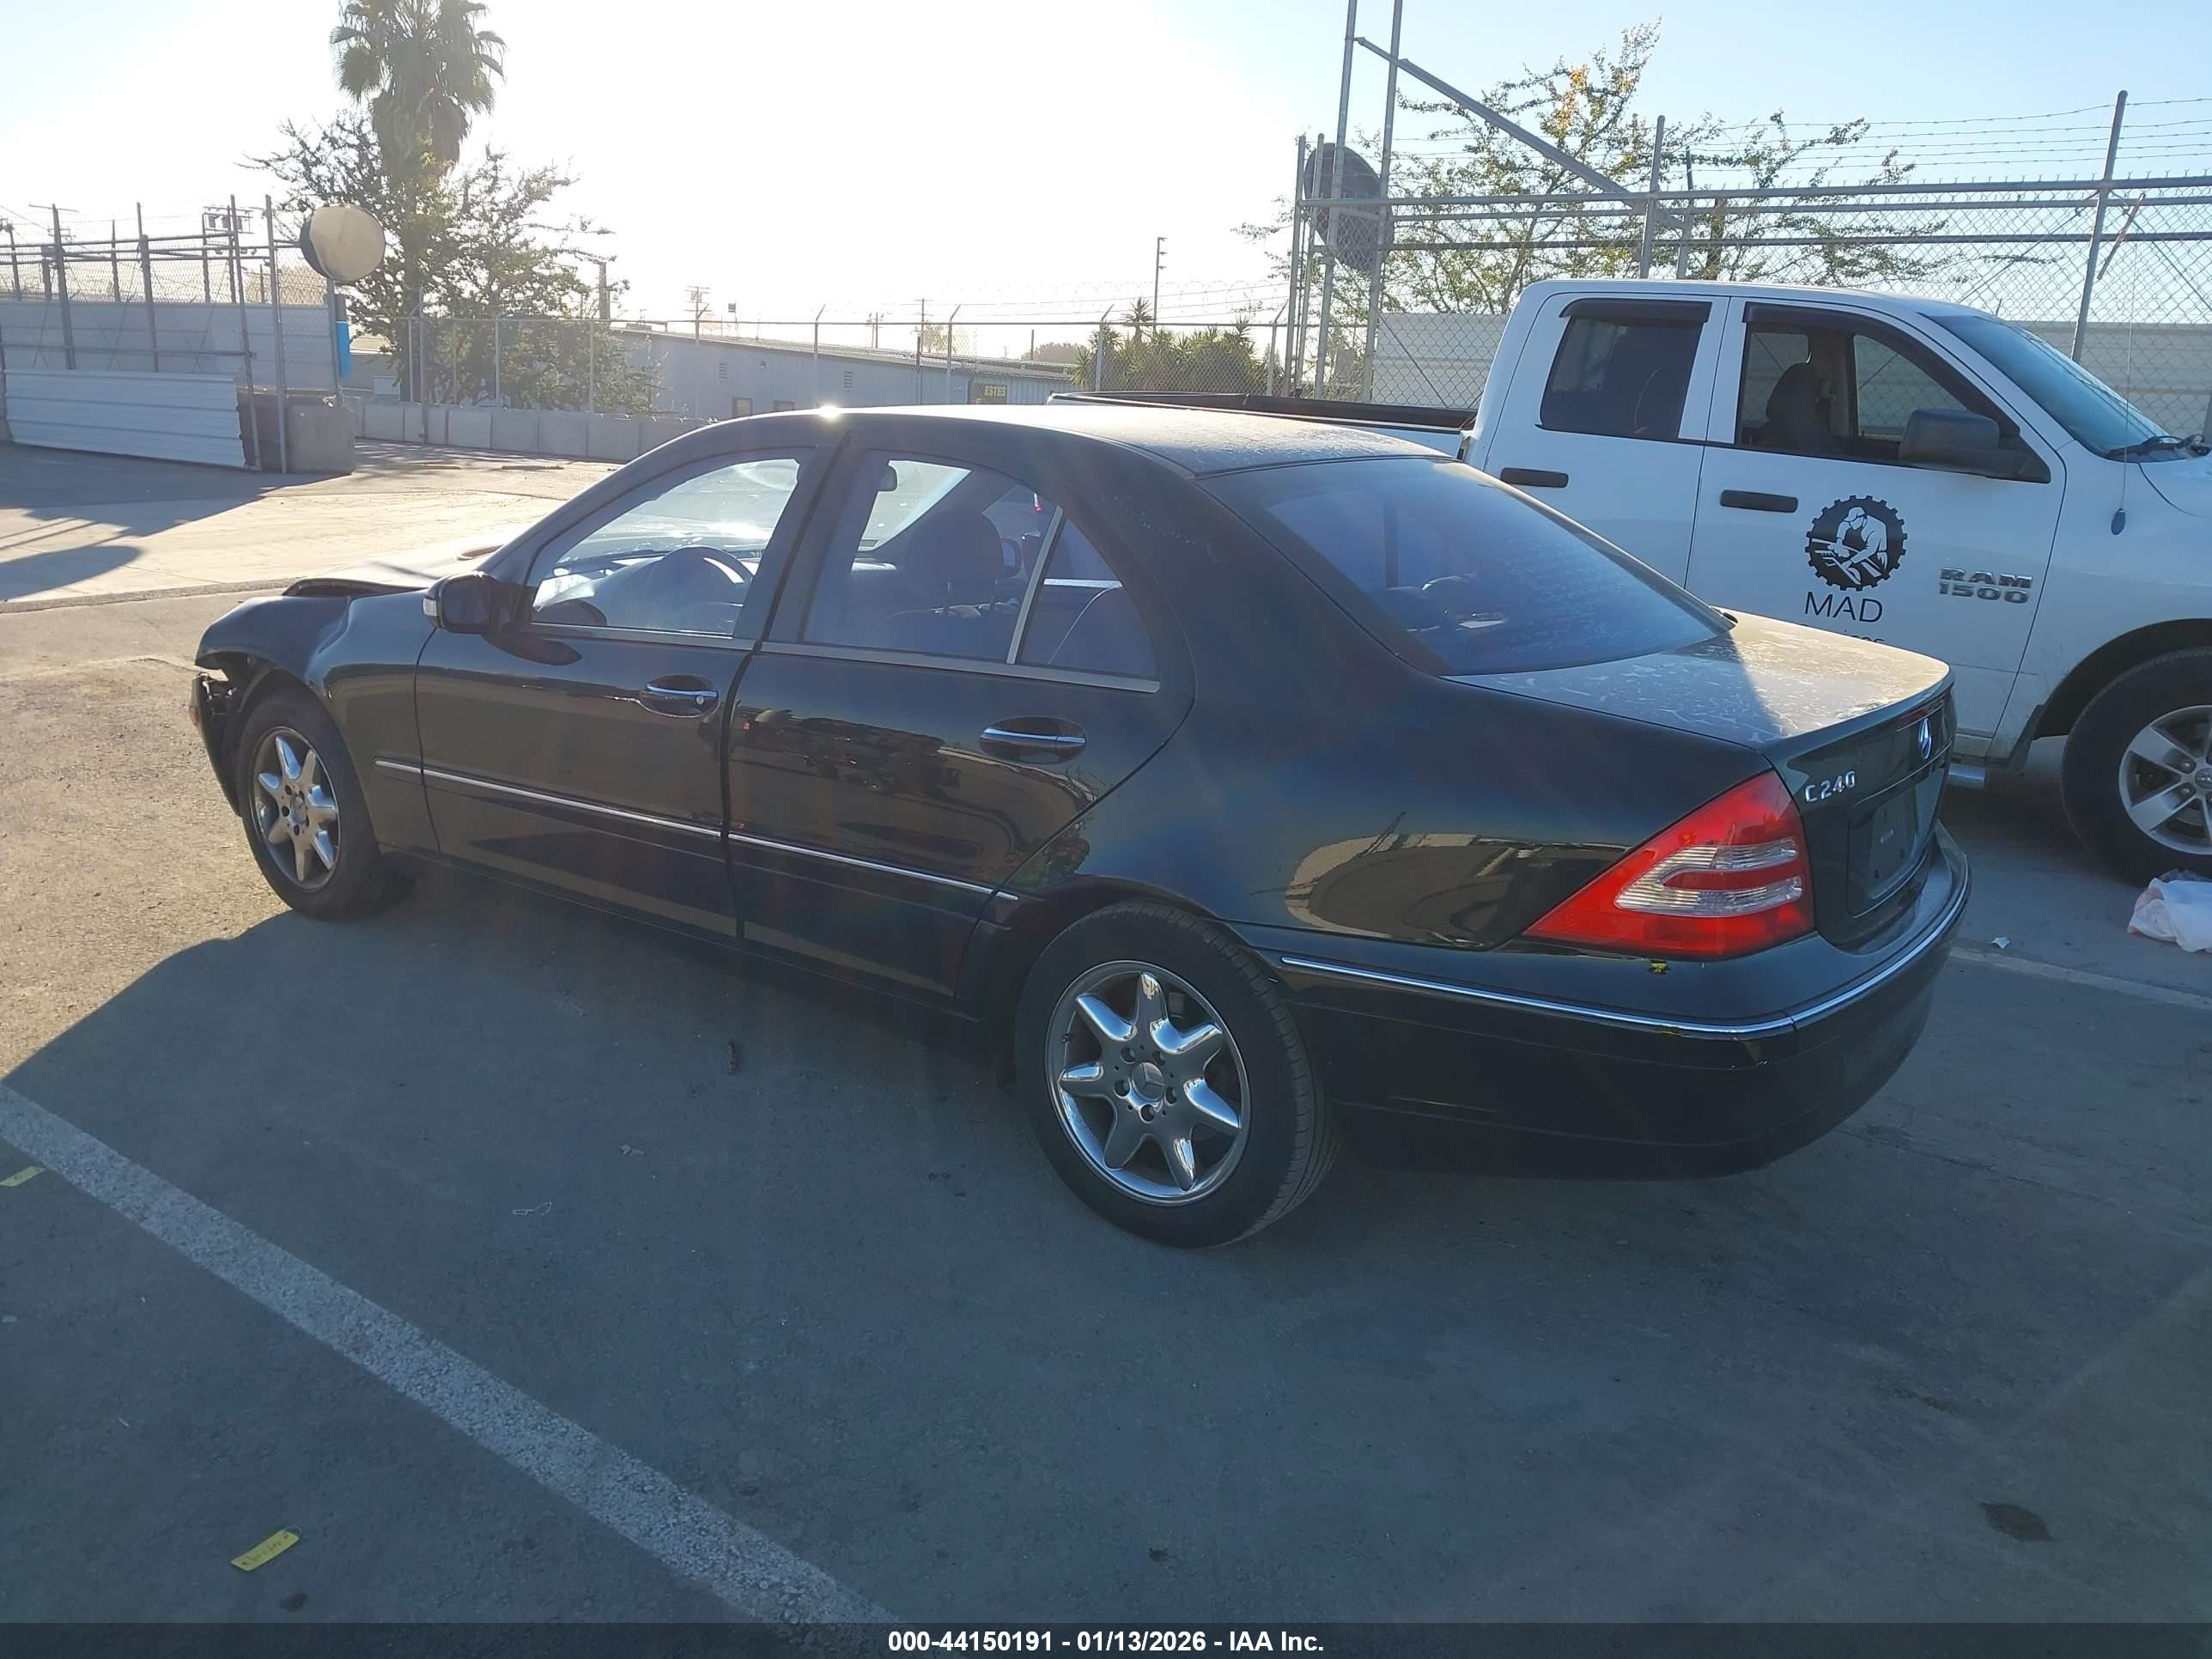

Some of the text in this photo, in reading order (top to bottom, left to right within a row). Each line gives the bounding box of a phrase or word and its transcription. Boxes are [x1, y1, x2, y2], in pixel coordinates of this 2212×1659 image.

[1941, 567, 2033, 588] RAM
[1939, 580, 2028, 604] 1500
[1805, 591, 1883, 623] MAD
[1805, 770, 1856, 804] C240
